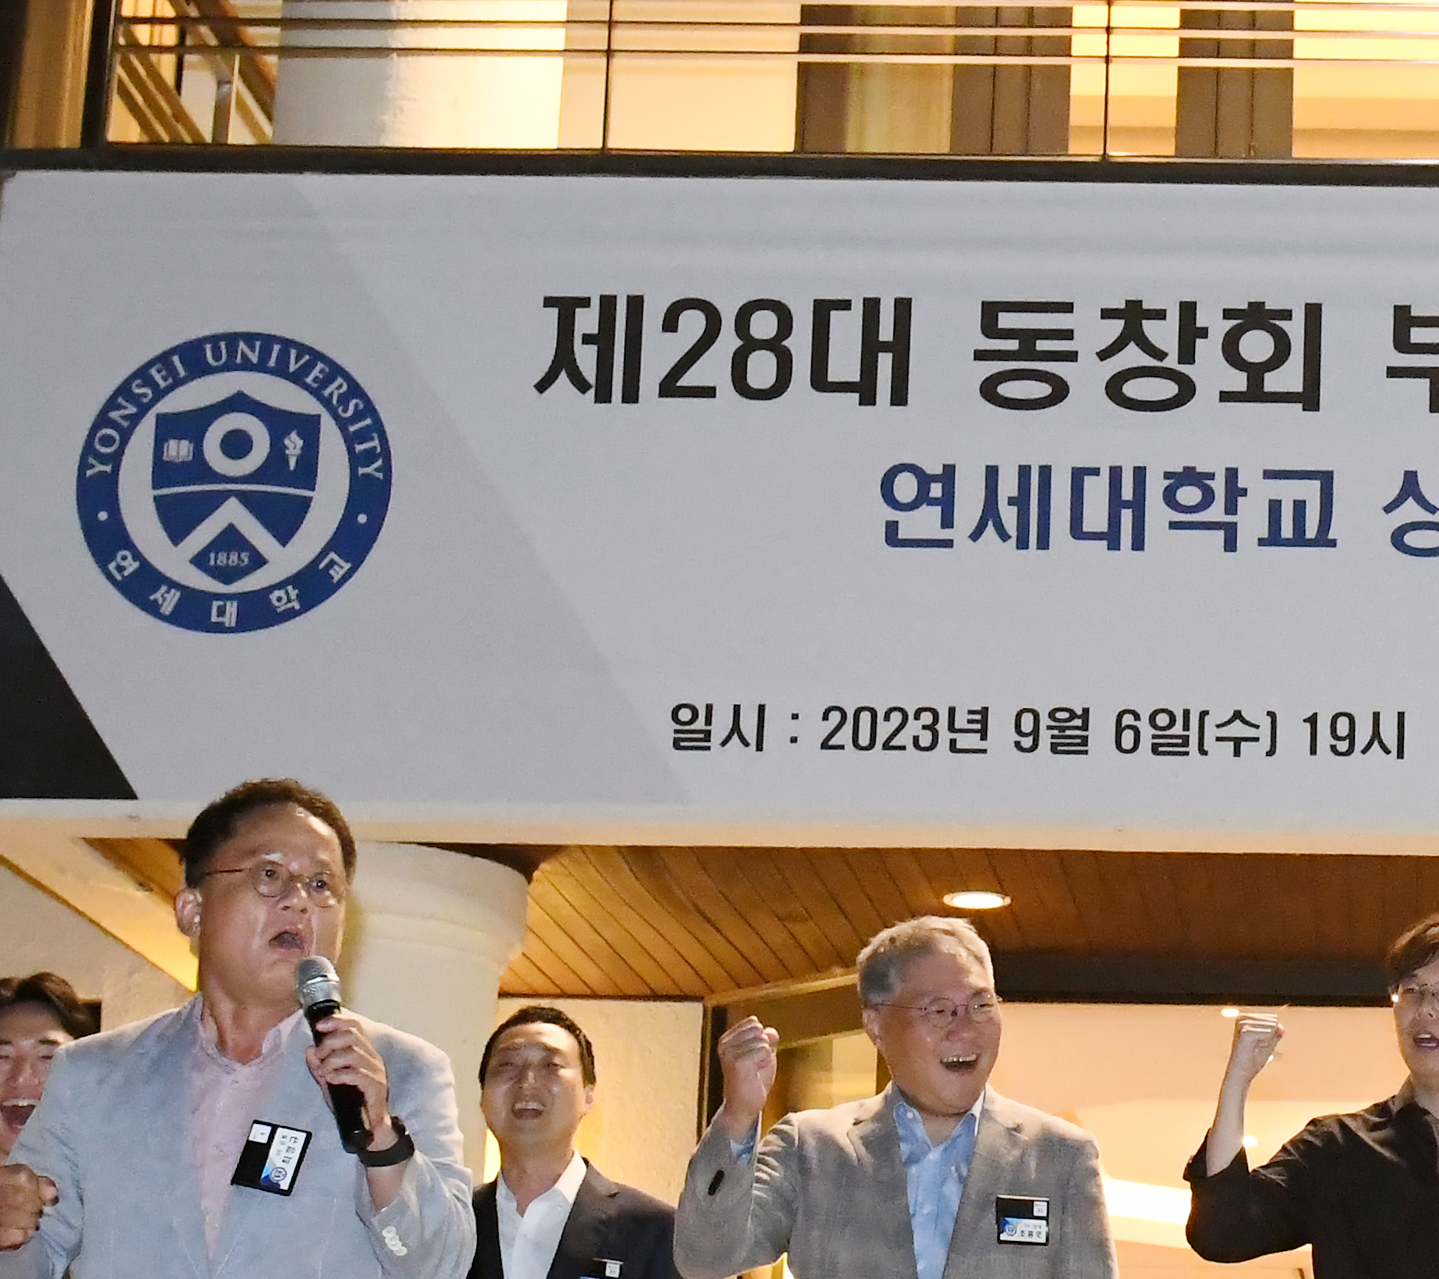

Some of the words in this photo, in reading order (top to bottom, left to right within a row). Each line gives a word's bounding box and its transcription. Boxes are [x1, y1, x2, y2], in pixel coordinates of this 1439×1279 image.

[533, 294, 913, 407] 제28대
[973, 299, 1323, 413] 동창회
[86, 354, 189, 478] YONSEI
[205, 341, 384, 481] UNIVERSITY
[879, 462, 1338, 553] 연세대학교
[107, 550, 352, 628] 연세대학교
[208, 552, 249, 567] 1885
[670, 703, 766, 753] 일시
[820, 705, 989, 755] 2023년
[1013, 706, 1090, 756] 9월
[1114, 707, 1278, 758] 6일(수)
[1302, 711, 1406, 760] 19시
